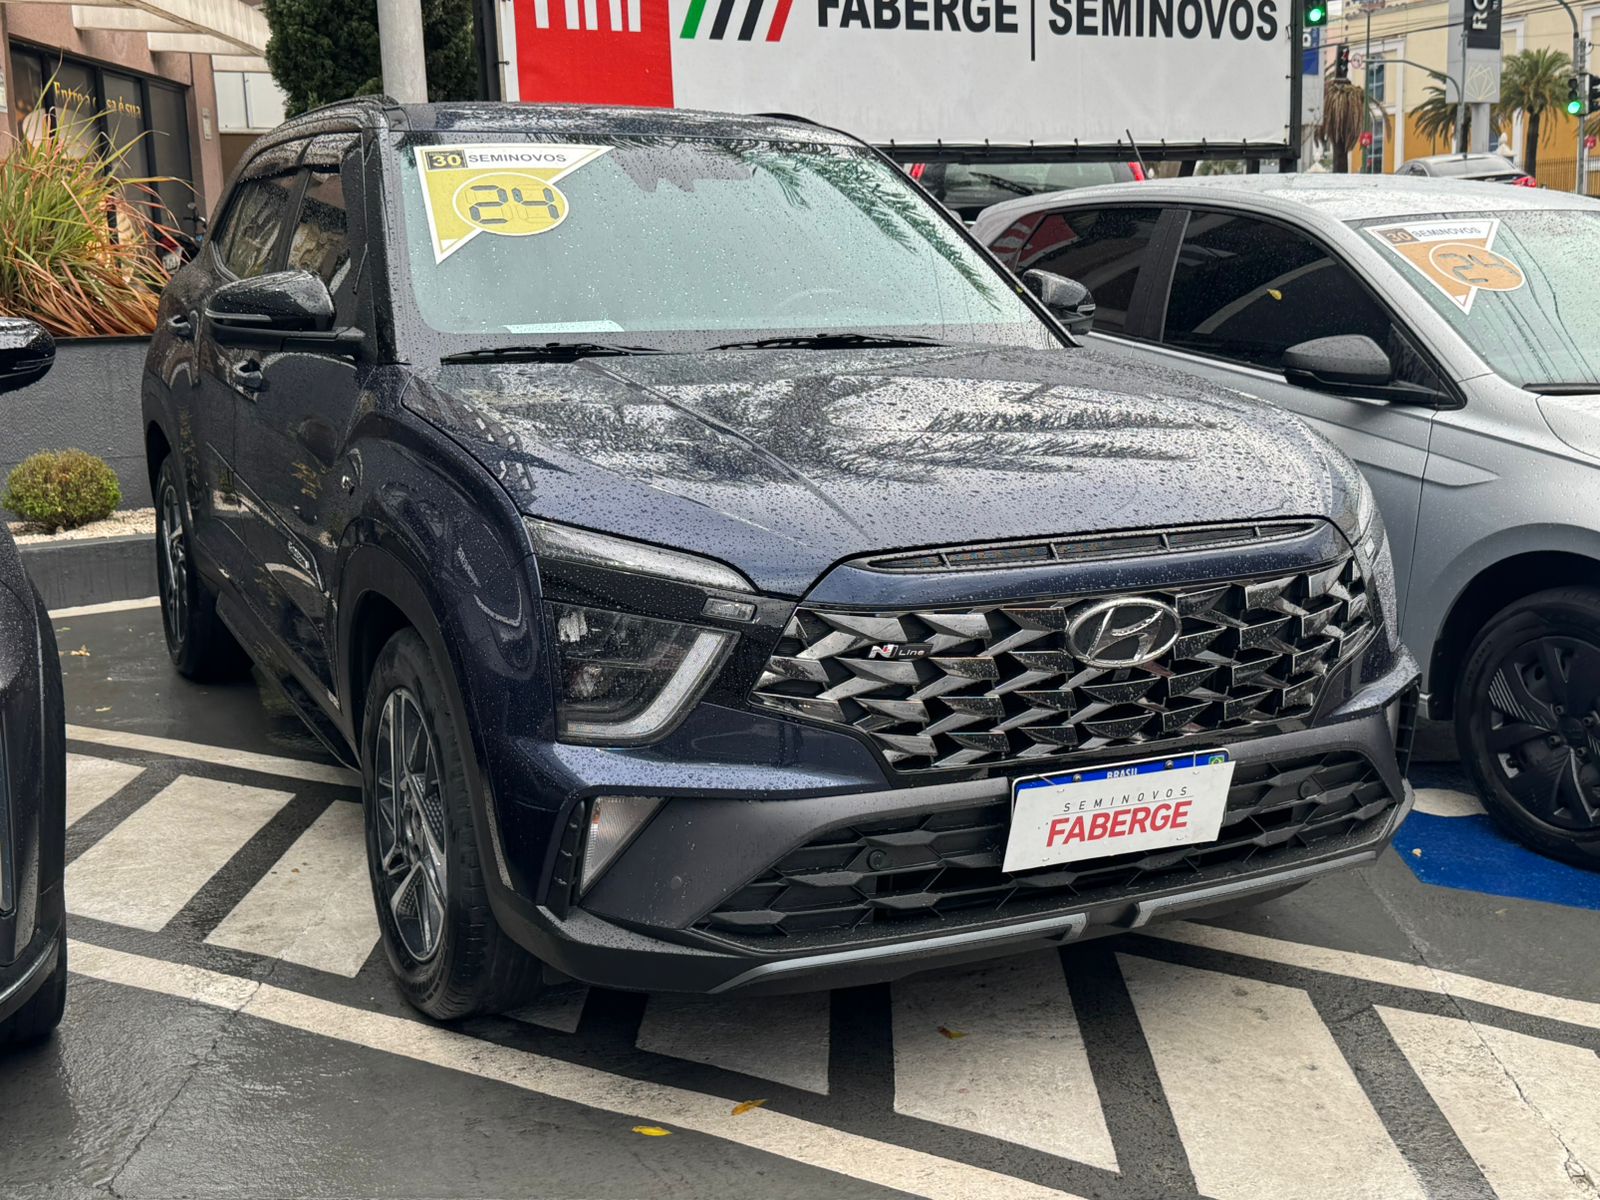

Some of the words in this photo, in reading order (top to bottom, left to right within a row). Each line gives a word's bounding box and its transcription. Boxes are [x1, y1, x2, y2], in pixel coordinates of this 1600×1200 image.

[818, 0, 1018, 33] FABERGE
[1048, 0, 1278, 41] SEMINOVOS
[432, 154, 462, 167] 30
[468, 153, 567, 163] SEMINOVOS
[469, 185, 560, 224] 24
[1386, 231, 1412, 242] 30
[1411, 227, 1482, 238] SEMINOVOS
[1064, 786, 1188, 812] SEMINOVOS
[1046, 800, 1193, 847] FABERGE
